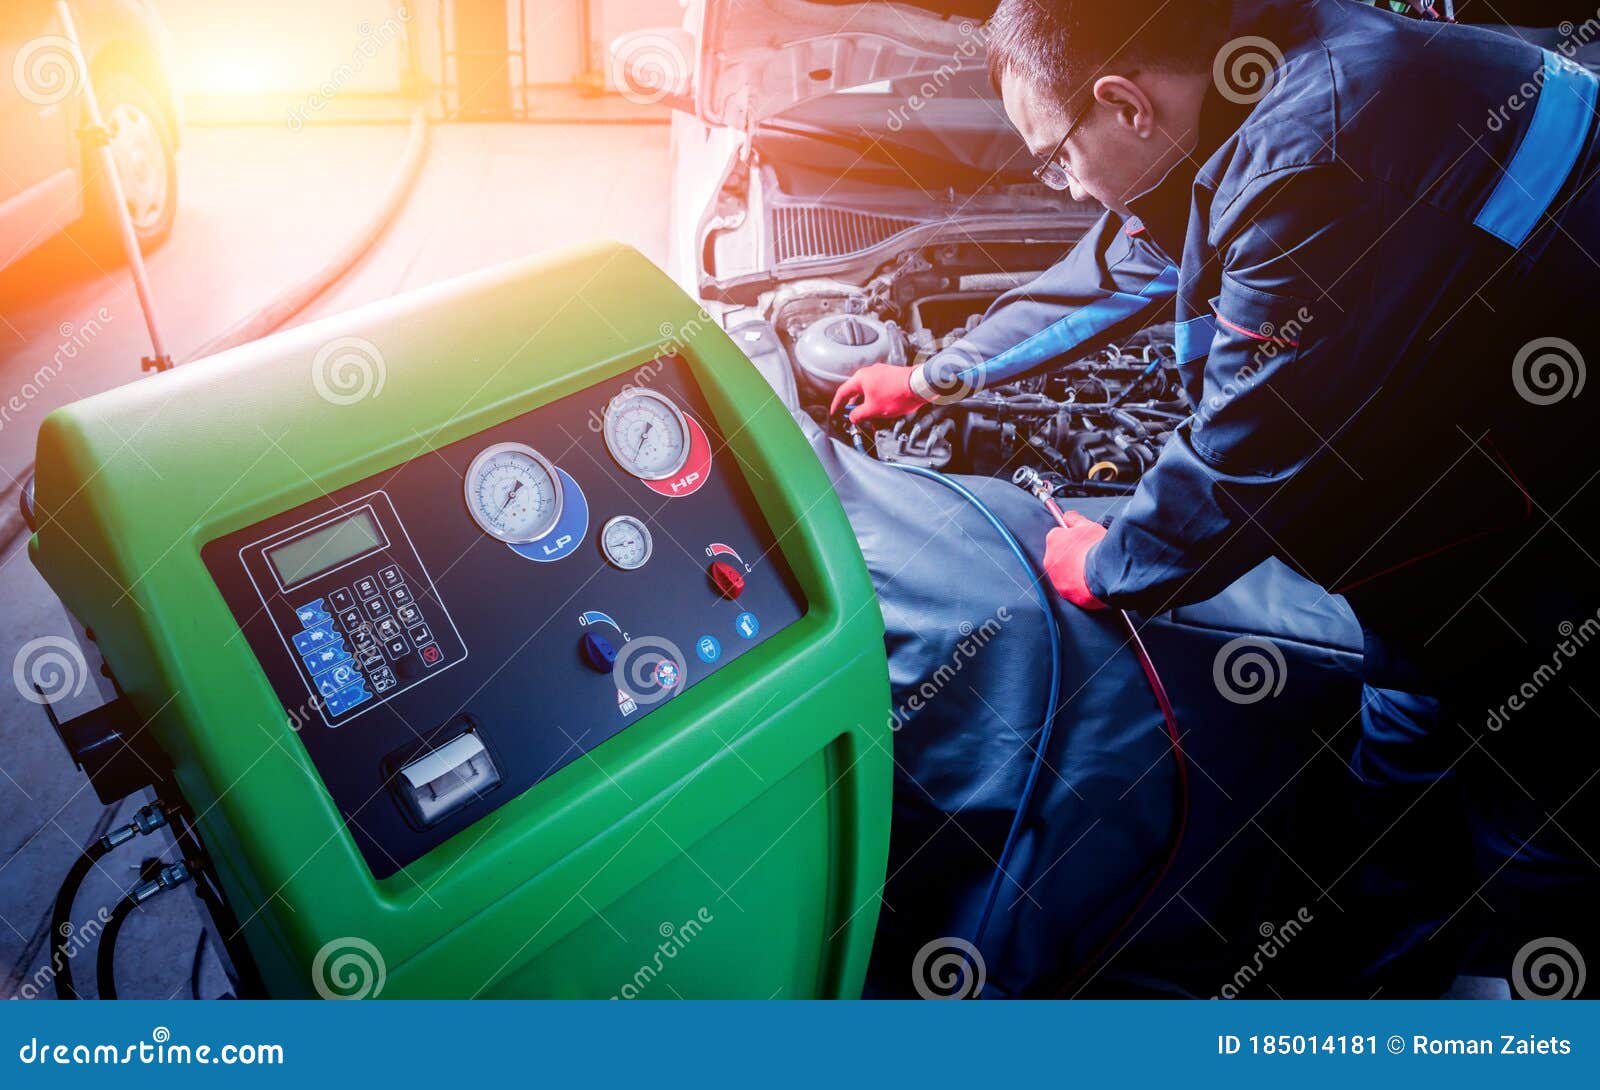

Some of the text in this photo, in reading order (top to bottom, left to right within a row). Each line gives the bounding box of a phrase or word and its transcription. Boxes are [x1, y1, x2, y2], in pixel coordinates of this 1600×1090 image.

[670, 472, 700, 492] HP
[542, 535, 572, 555] LP
[361, 581, 371, 591] 2
[371, 601, 381, 610] 5
